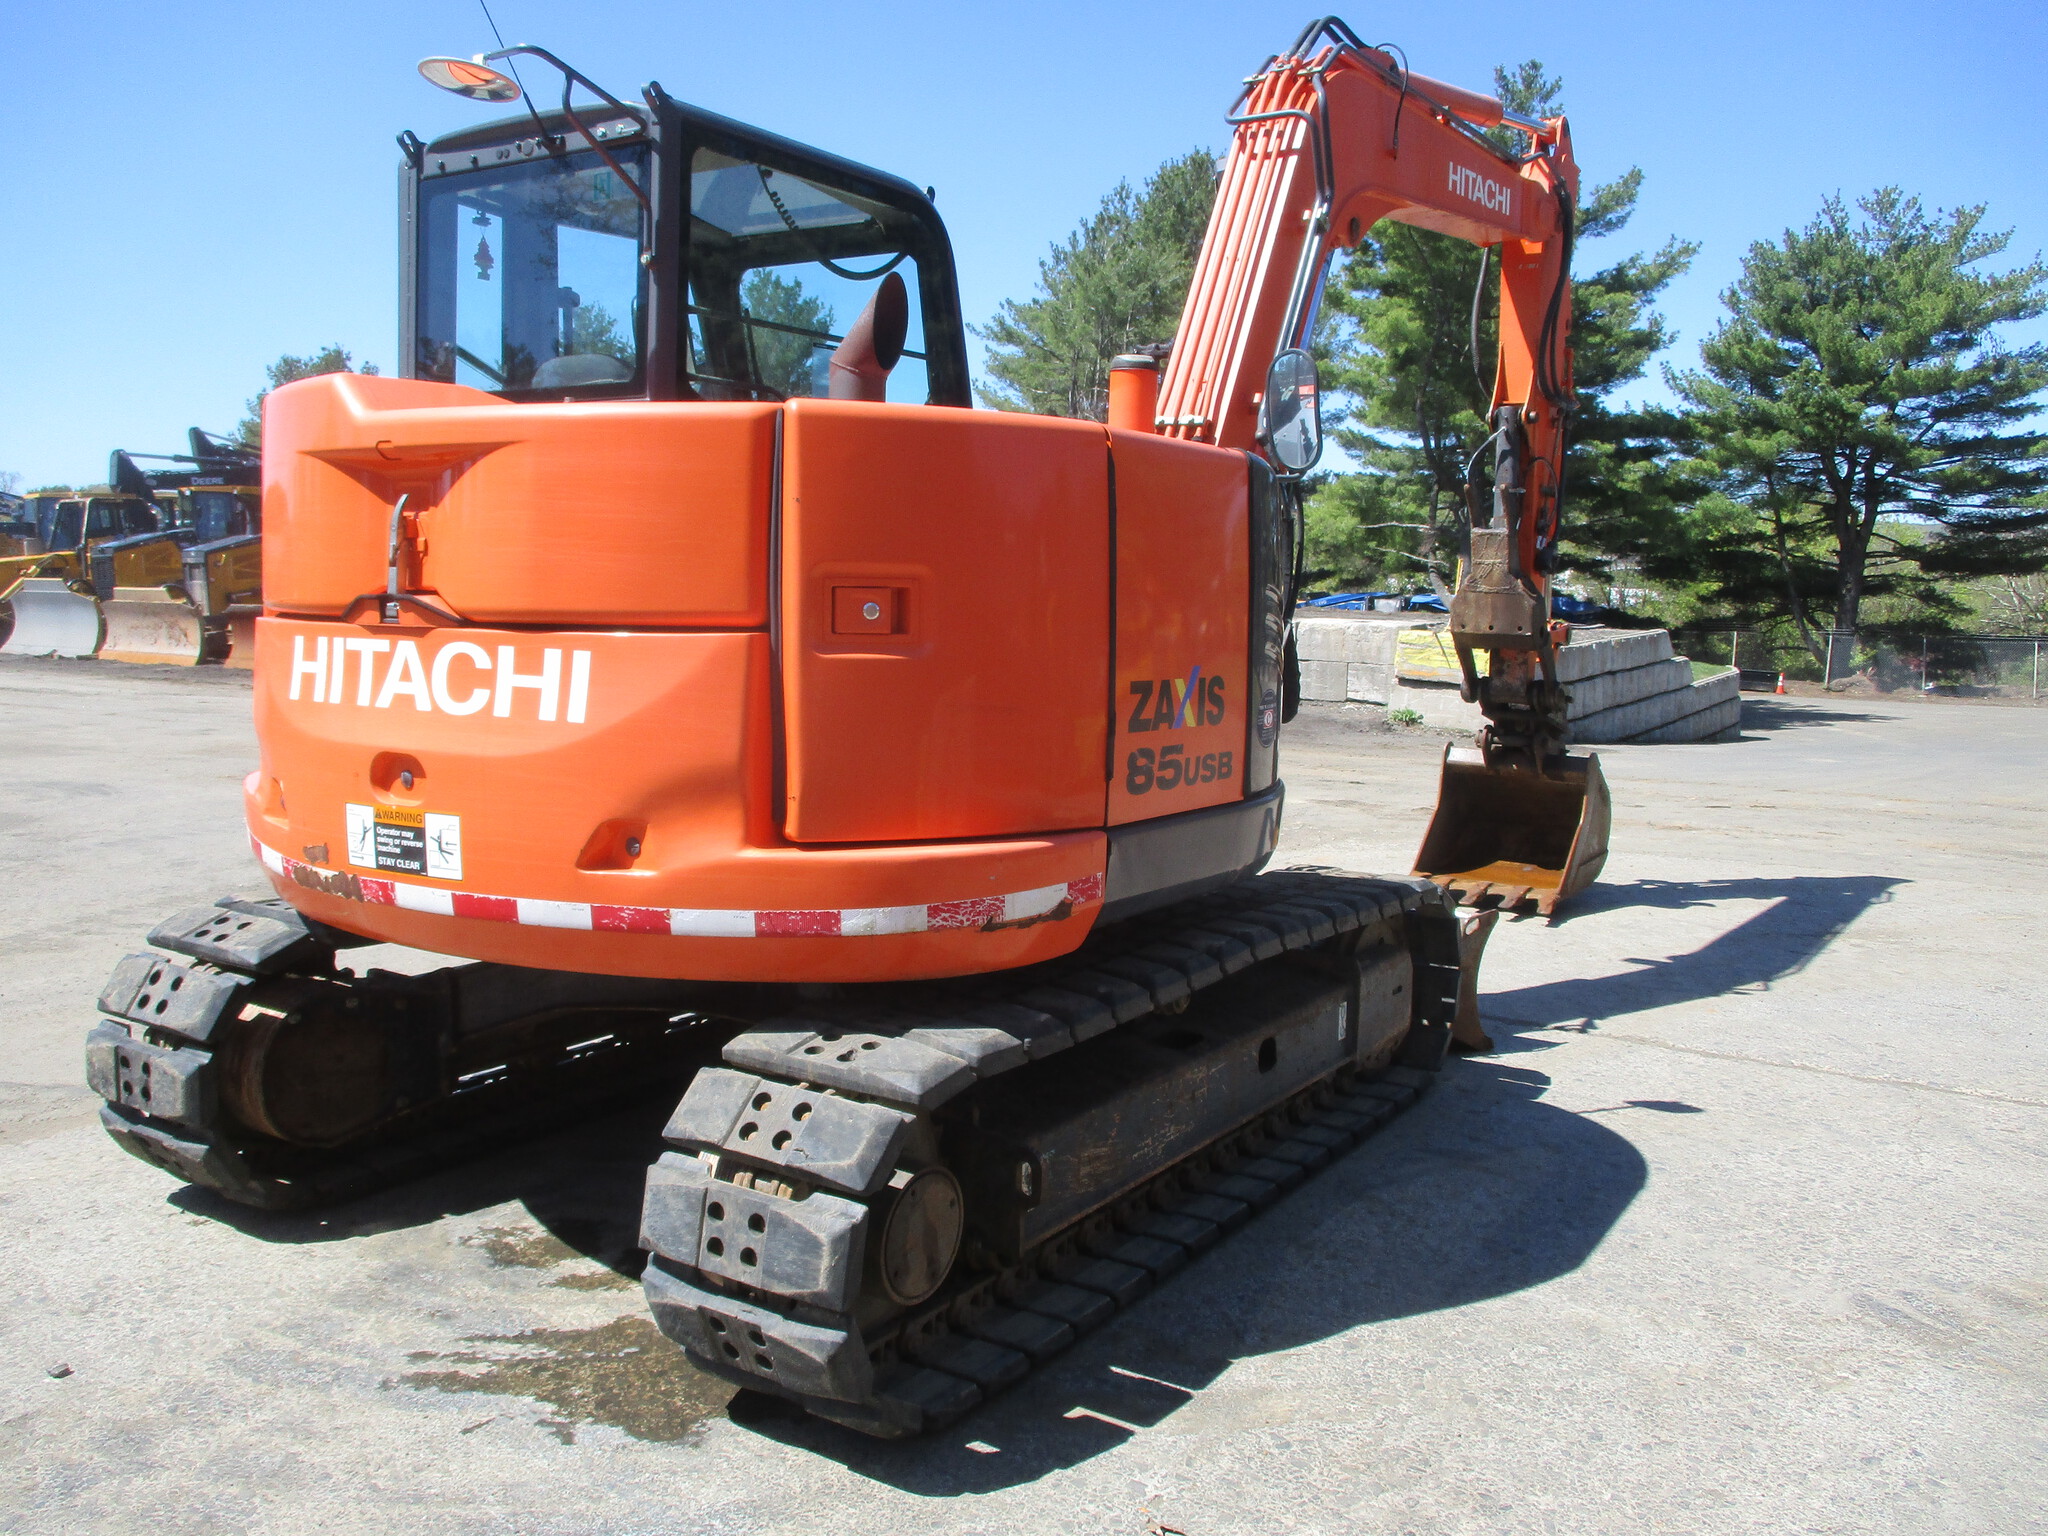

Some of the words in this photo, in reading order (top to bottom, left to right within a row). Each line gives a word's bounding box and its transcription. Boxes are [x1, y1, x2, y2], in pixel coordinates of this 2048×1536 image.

[1448, 161, 1511, 215] HITACHI
[191, 477, 224, 485] DEERE
[289, 635, 592, 724] HITACHI
[1127, 665, 1226, 733] ZAXIS
[382, 811, 423, 824] WARNING
[376, 826, 400, 837] Operator
[401, 830, 415, 840] may
[377, 836, 394, 846] swing
[401, 840, 423, 848] reverse
[377, 845, 401, 854] machine
[378, 856, 395, 866] STAY
[396, 859, 420, 870] CLEAR
